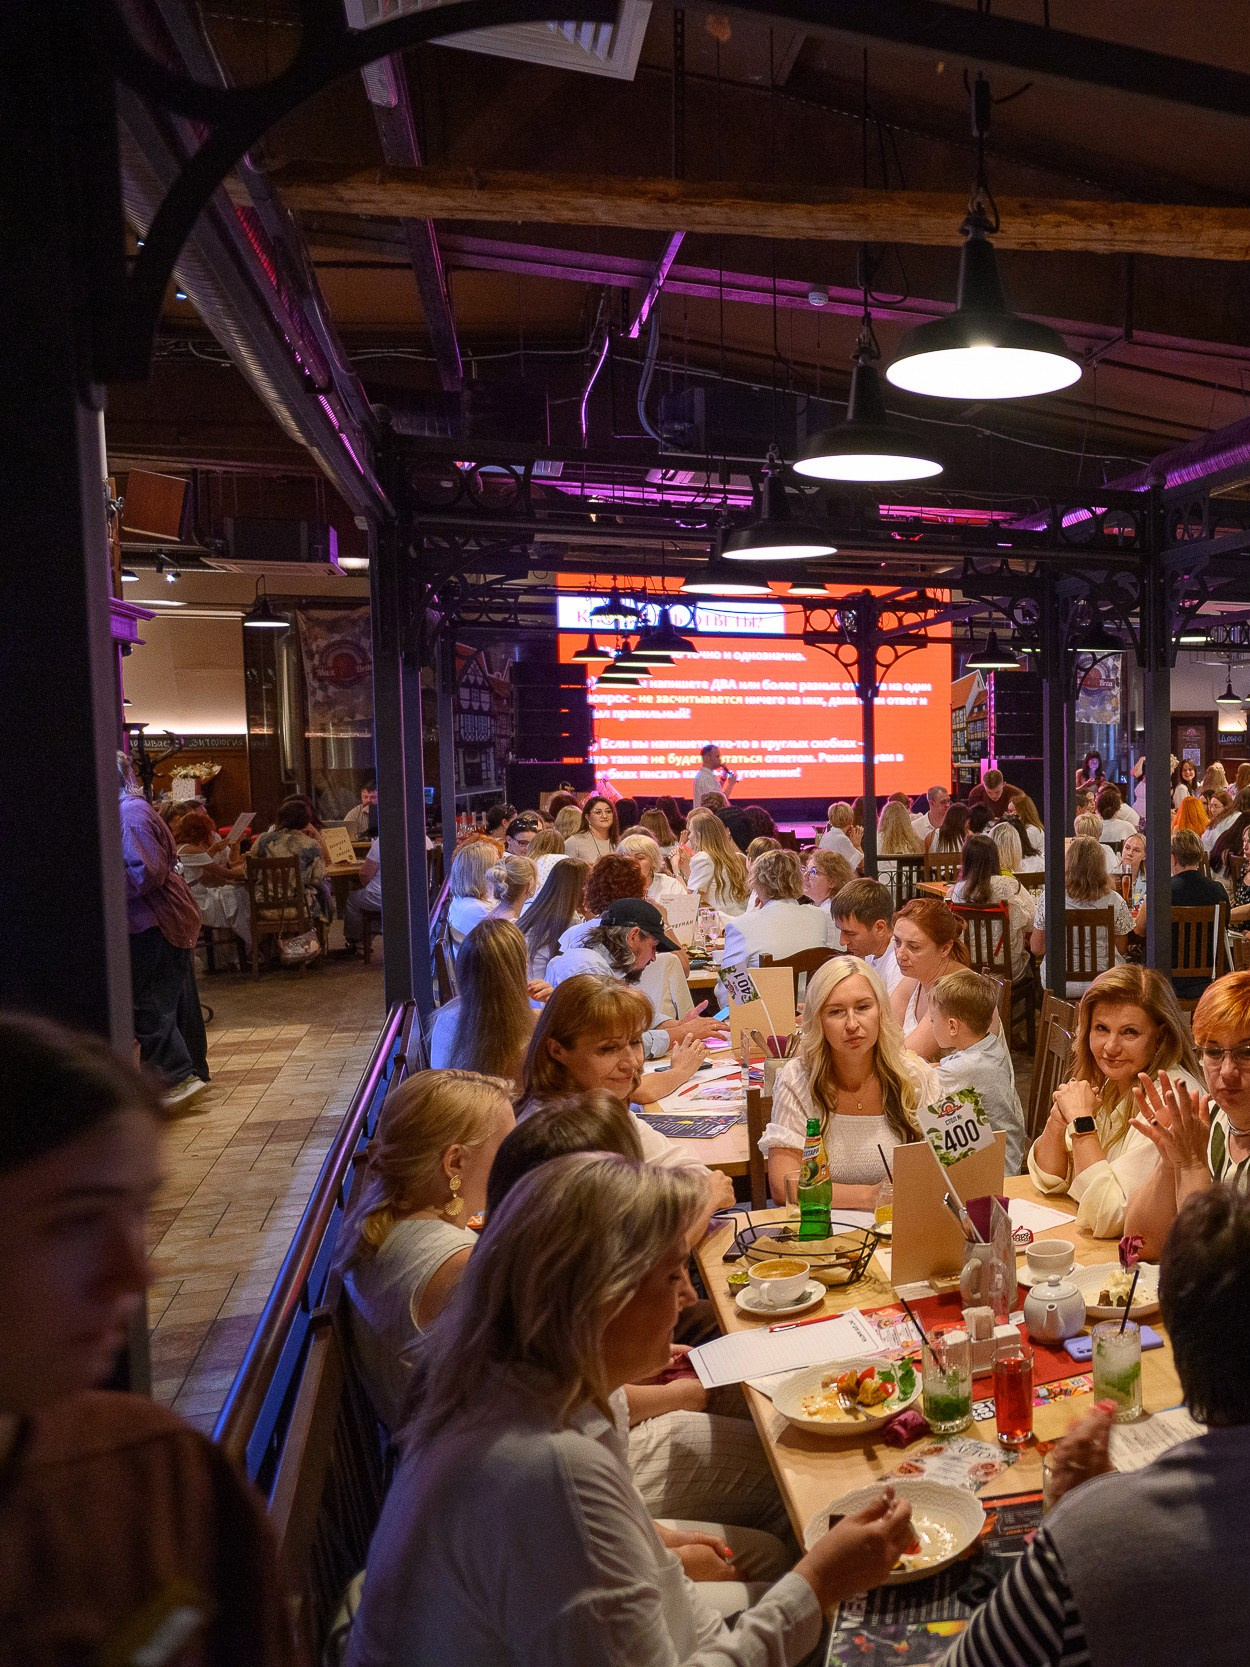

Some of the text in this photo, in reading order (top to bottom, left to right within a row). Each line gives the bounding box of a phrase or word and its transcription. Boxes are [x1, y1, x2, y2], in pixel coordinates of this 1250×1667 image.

[733, 651, 806, 662] однозначно.
[651, 679, 709, 690] напишете
[710, 679, 738, 692] ДВА
[738, 680, 761, 690] или
[762, 679, 797, 691] более
[799, 681, 841, 692] разных
[904, 683, 932, 694] один
[638, 695, 653, 703] не
[656, 695, 743, 704] засчитывается
[745, 695, 790, 704] ничего
[828, 697, 857, 707] даже
[887, 697, 916, 706] ответ
[612, 707, 691, 721] правильный!
[601, 739, 630, 749] Если
[631, 740, 649, 749] вы
[650, 740, 709, 750] напишете
[761, 741, 808, 752] круглых
[810, 739, 857, 750] скобках
[611, 756, 649, 765] также
[650, 756, 665, 765] не
[764, 756, 816, 765] ответом.
[639, 771, 681, 780] писать
[735, 768, 802, 781] уточнения!
[733, 972, 751, 995] 401
[944, 1118, 981, 1152] 400
